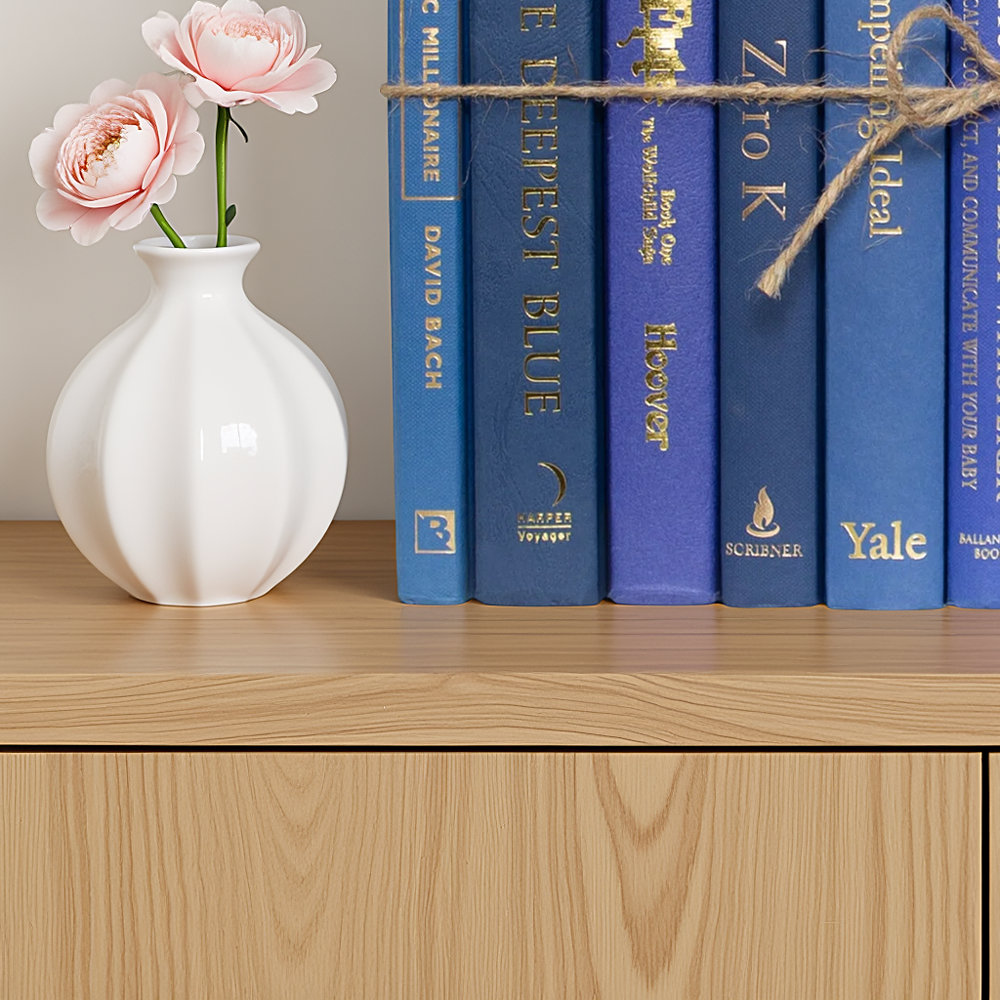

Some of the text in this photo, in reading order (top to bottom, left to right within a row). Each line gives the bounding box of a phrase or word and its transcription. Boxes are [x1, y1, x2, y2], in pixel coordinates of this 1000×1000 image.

[741, 39, 787, 221] Zro K
[960, 57, 980, 148] COECT,
[520, 58, 560, 270] DEEPEST
[869, 150, 904, 238] Ideal
[962, 152, 979, 192] AND
[424, 225, 442, 389] DAVID BACH
[961, 198, 979, 333] COMMUNICATE
[522, 292, 561, 416] BLUE
[644, 323, 678, 451] Hoover
[961, 338, 978, 386] WITH
[961, 392, 978, 439] YOUR
[961, 444, 978, 491] BABY
[725, 542, 804, 558] SCRIBNER
[840, 520, 928, 560] Yale
